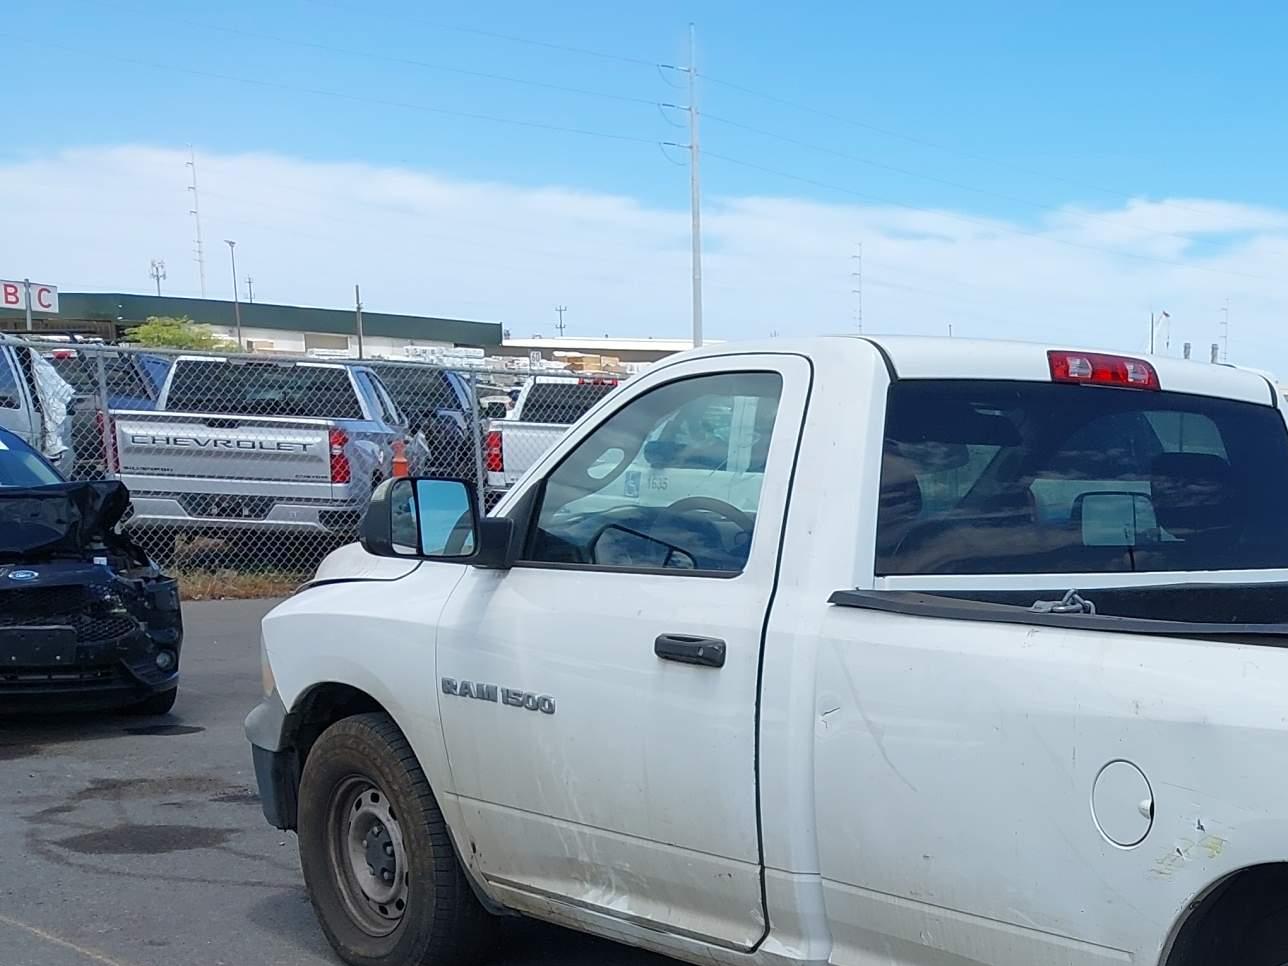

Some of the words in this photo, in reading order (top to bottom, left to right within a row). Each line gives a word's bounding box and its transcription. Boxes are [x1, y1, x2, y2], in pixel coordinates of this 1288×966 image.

[3, 284, 19, 304] B
[37, 288, 52, 308] C
[130, 434, 315, 453] CHEVROLET
[441, 677, 498, 702] RAM
[500, 688, 556, 715] 1500
